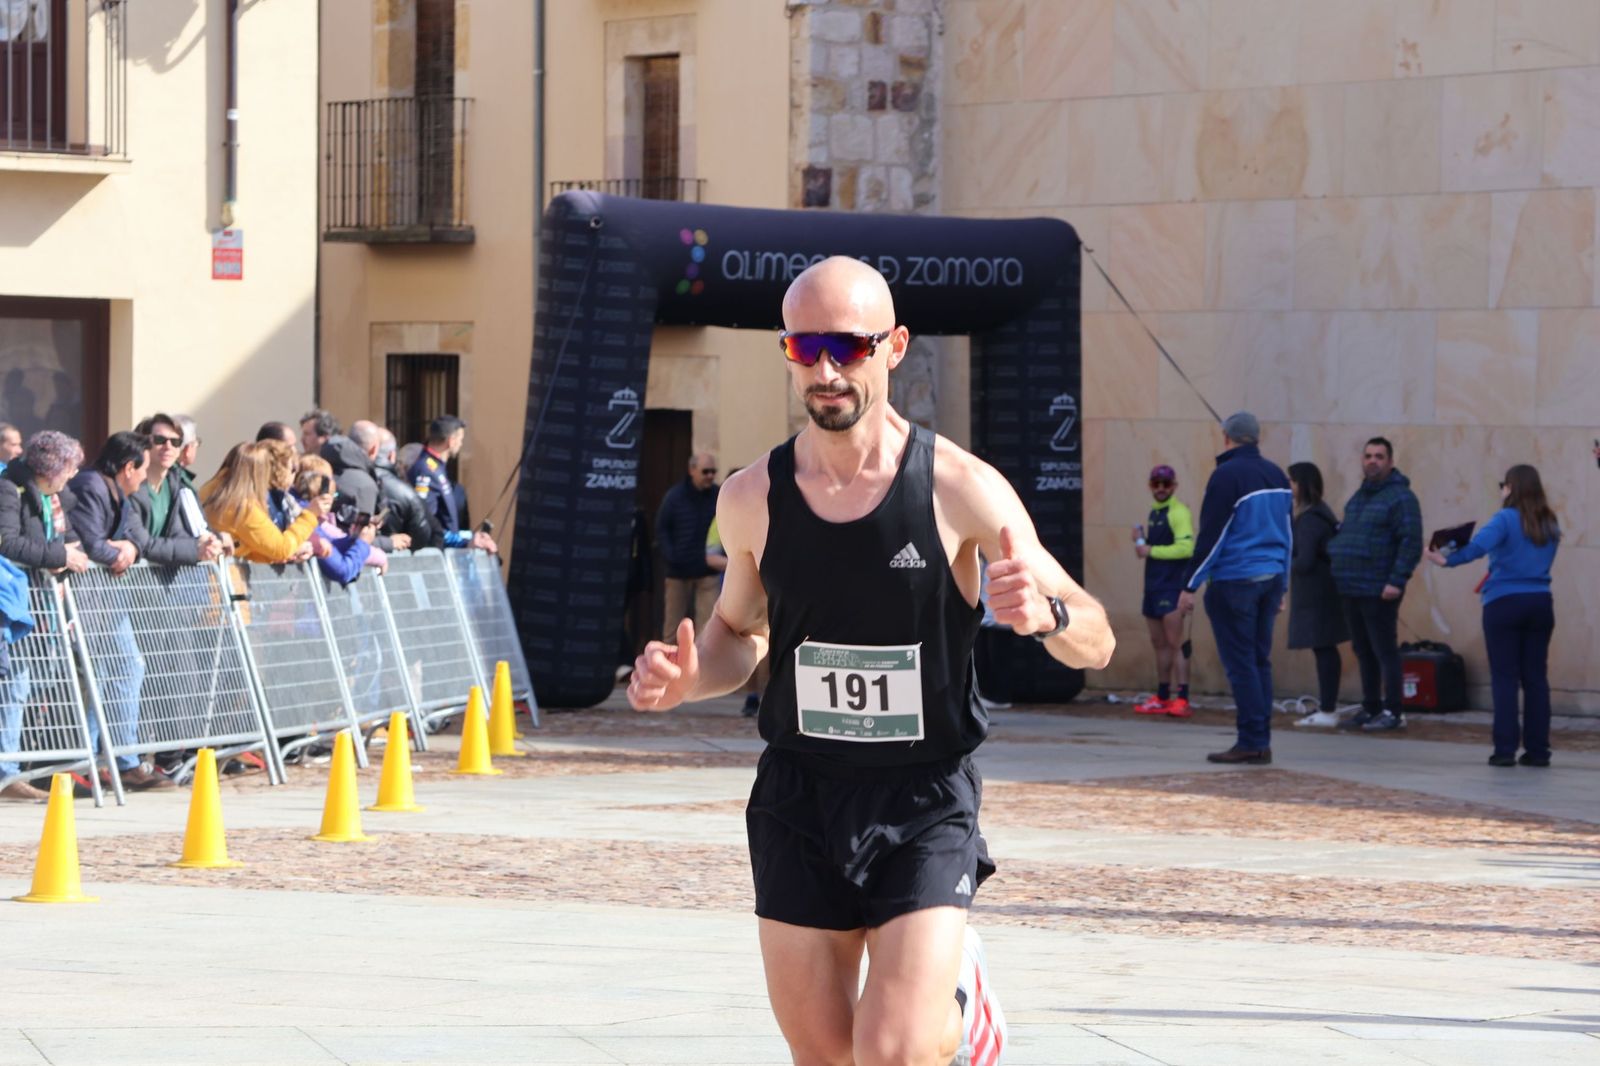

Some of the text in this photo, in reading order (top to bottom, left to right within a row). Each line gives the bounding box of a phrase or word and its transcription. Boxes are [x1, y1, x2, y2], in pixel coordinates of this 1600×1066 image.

[905, 256, 1024, 287] zamora
[889, 558, 927, 569] adidas
[821, 671, 889, 712] 191
